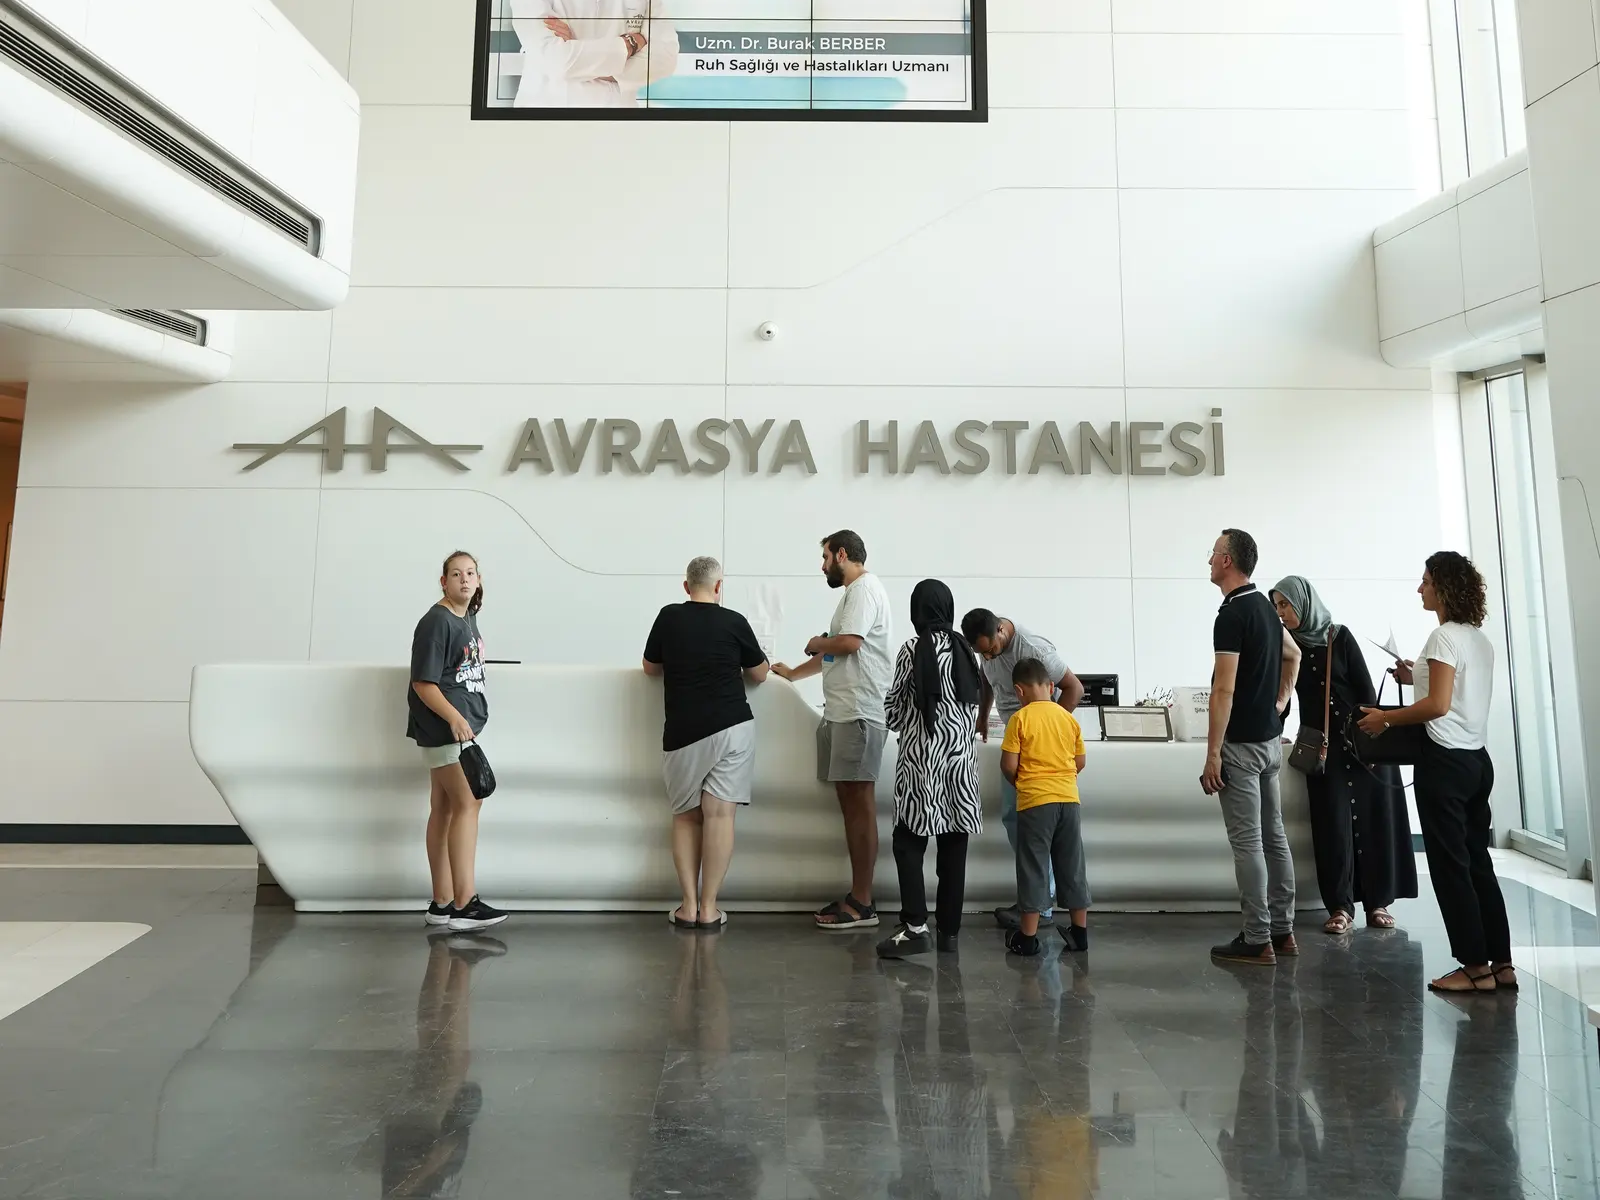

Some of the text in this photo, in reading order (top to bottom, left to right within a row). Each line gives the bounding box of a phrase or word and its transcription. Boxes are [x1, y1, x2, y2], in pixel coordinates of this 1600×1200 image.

[695, 36, 886, 51] Uzm. Dr. Burak BERBER
[695, 59, 949, 74] Ruh Sağlığı ve Hastalıkları Uzmanı
[507, 407, 1225, 477] AVRASYA HASTANESİ
